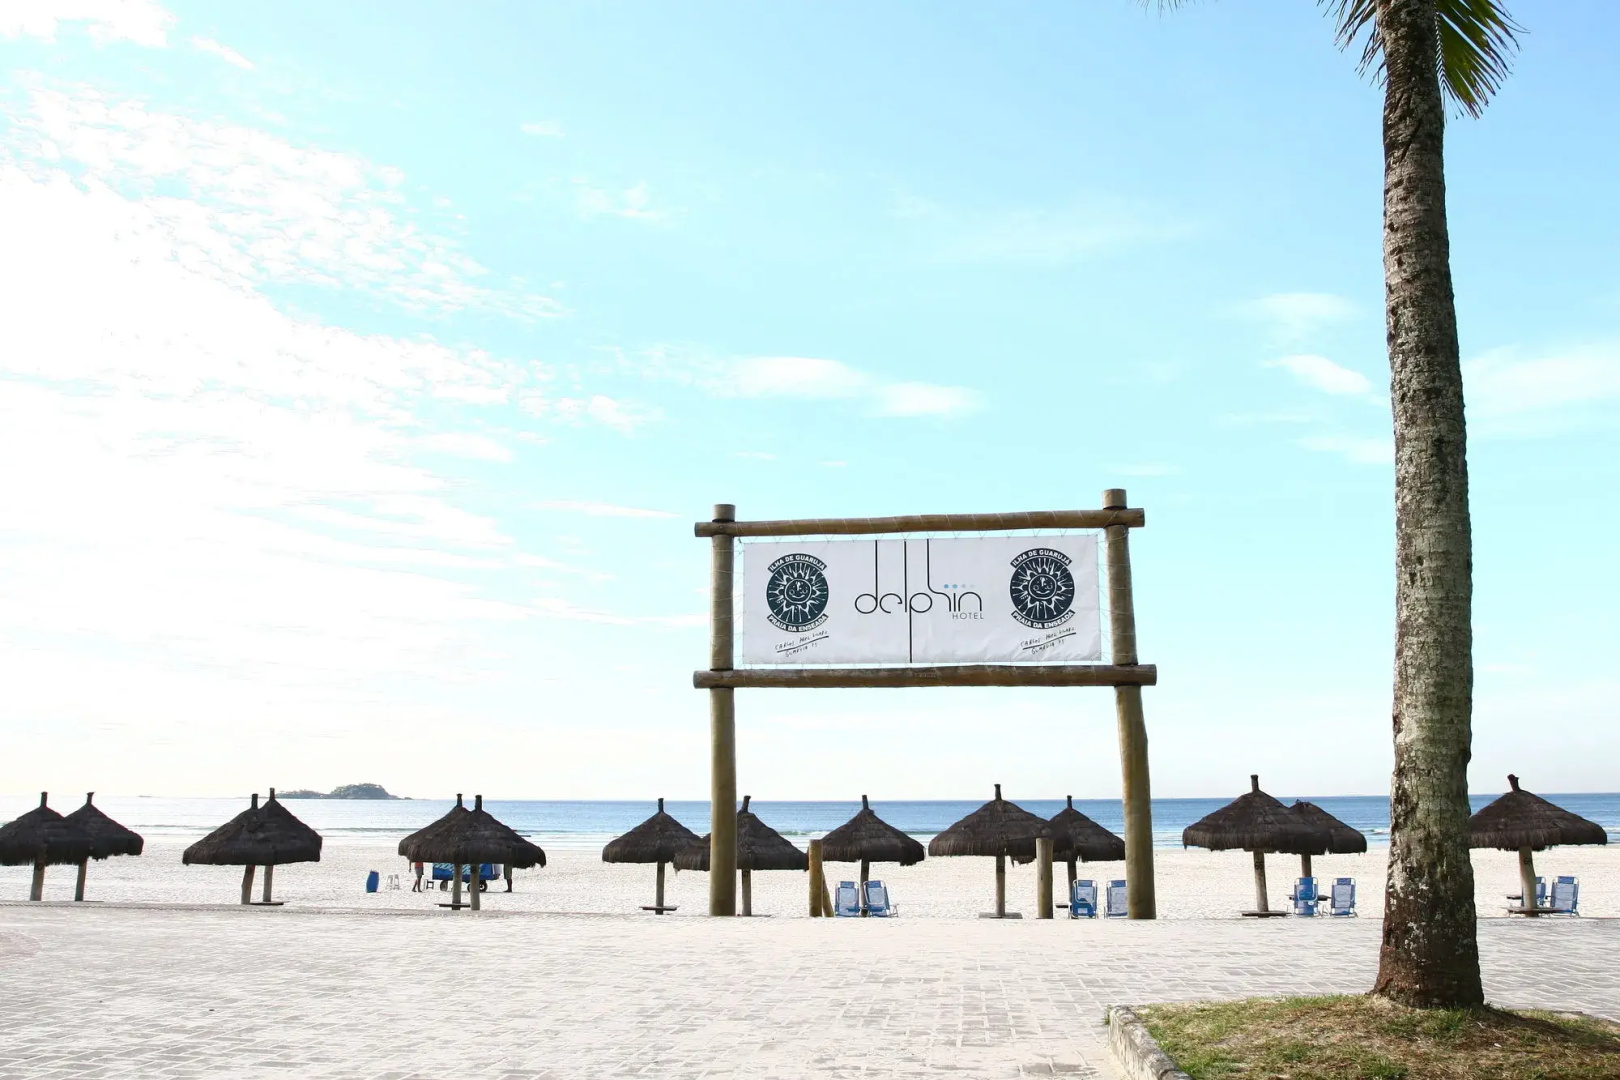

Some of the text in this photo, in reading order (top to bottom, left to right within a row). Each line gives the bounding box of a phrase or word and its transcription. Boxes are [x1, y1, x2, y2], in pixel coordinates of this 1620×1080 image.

[769, 558, 785, 571] ILHA
[1012, 553, 1028, 566] ILHA
[854, 538, 983, 663] delphin
[768, 615, 786, 631] PRAIA
[798, 615, 828, 632] ENSEADA
[952, 612, 984, 620] HOTEL
[1012, 611, 1031, 627] PRAIA
[1044, 611, 1074, 629] ENSEADA
